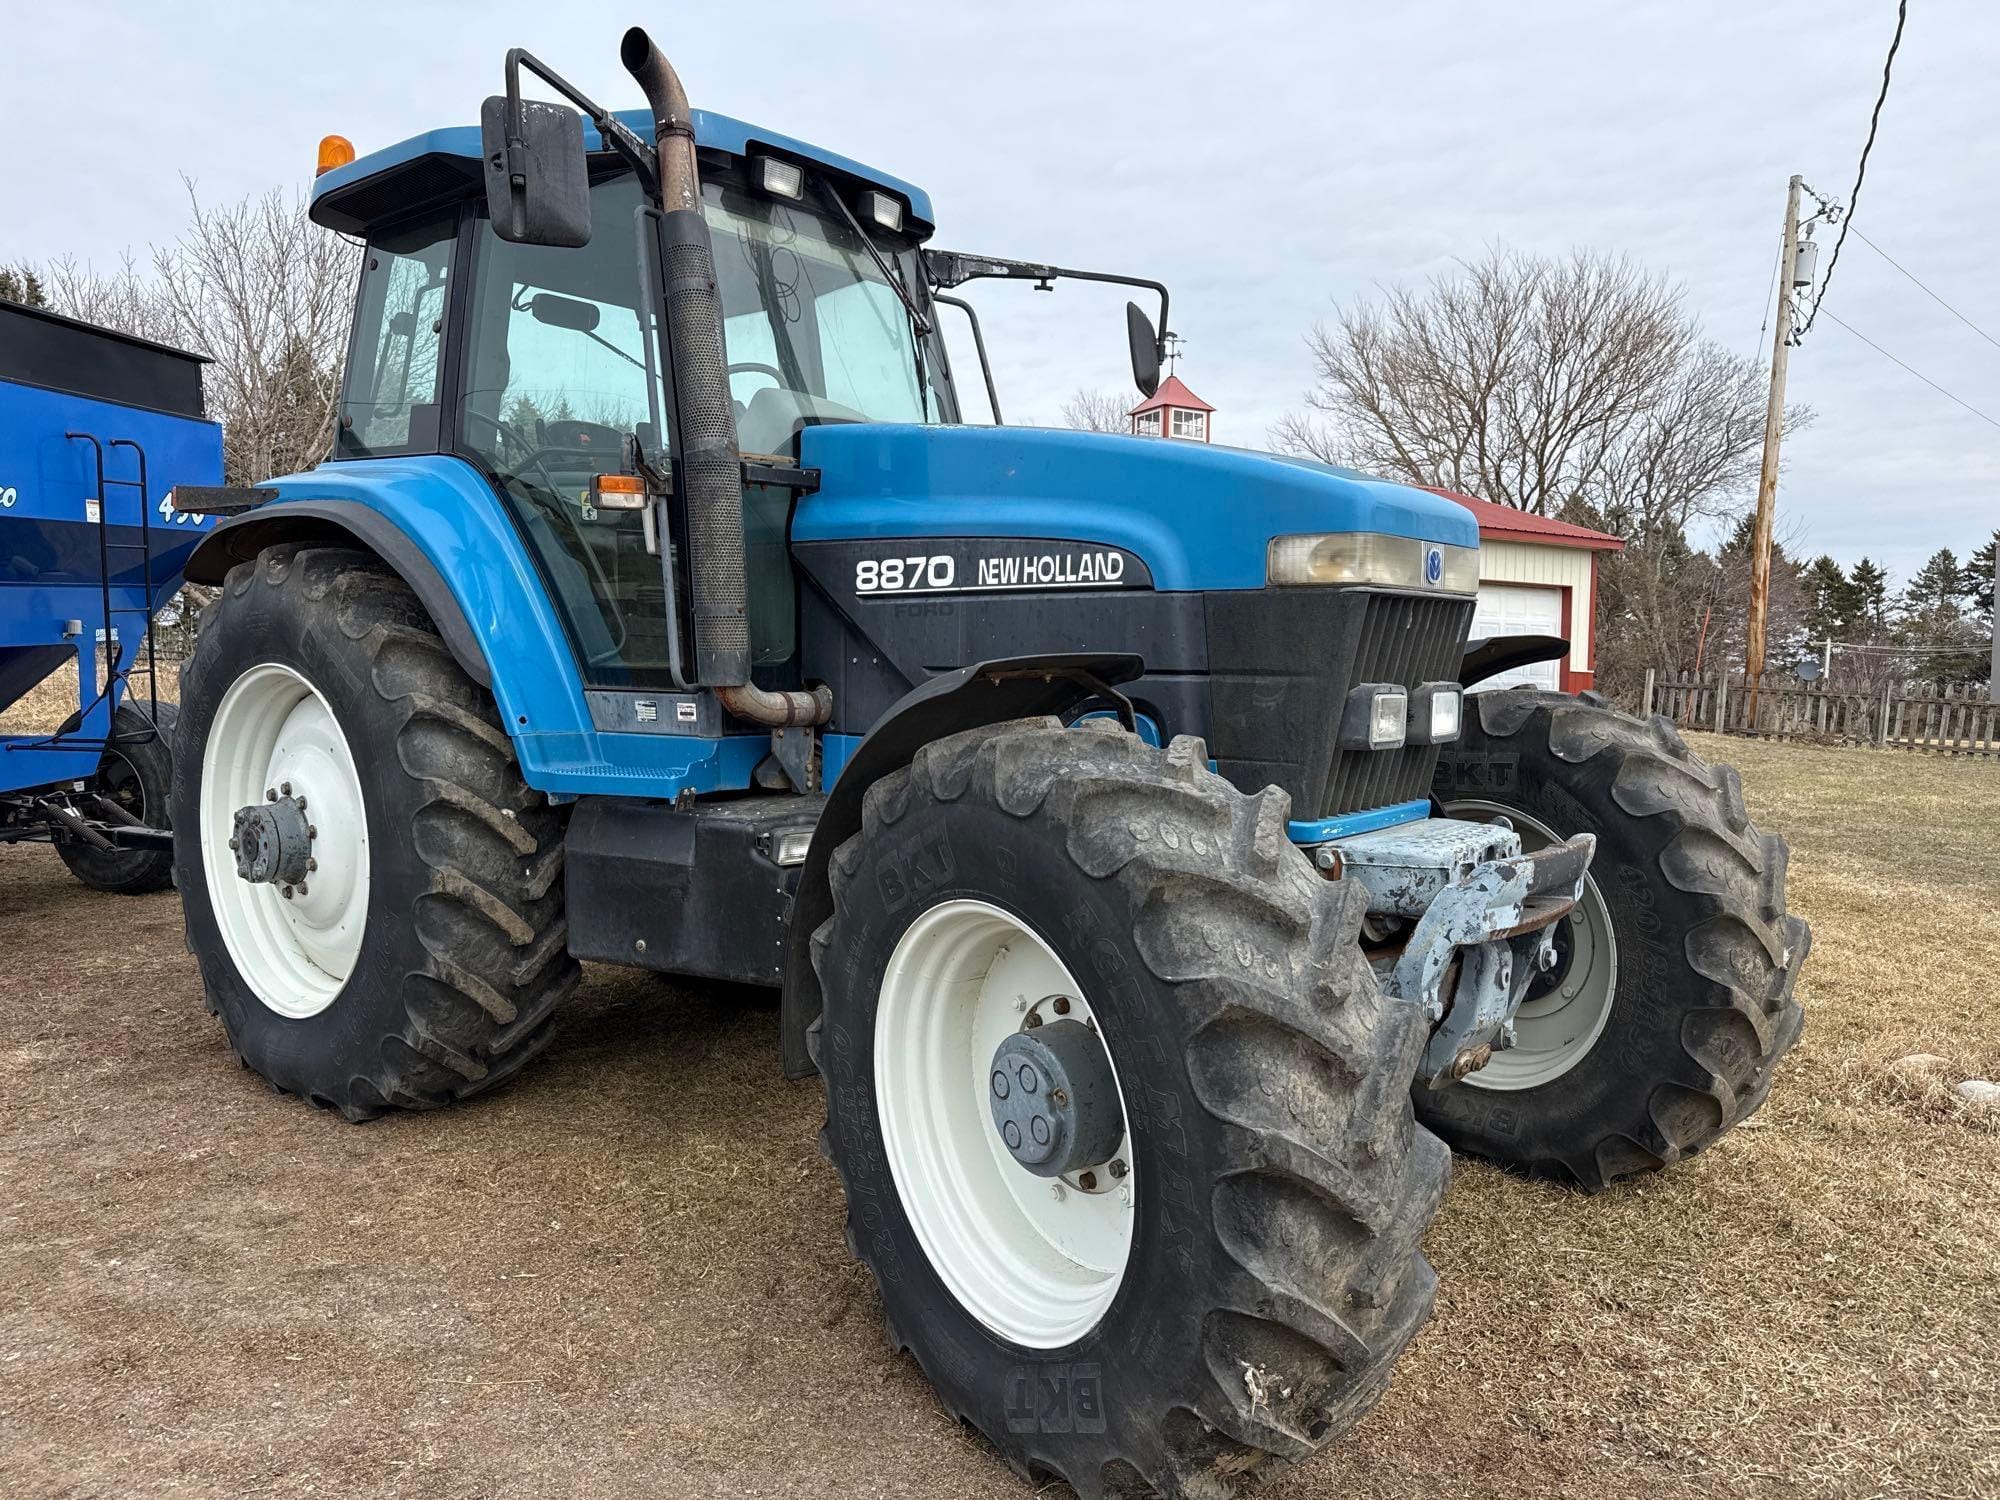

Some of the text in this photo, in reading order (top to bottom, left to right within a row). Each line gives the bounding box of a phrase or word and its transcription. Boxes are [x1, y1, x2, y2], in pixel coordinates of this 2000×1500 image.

[856, 552, 1124, 591] 8870 NEW HOLLAND
[894, 603, 955, 618] FORD
[877, 829, 953, 911] BKT
[1005, 1374, 1101, 1421] BKT
